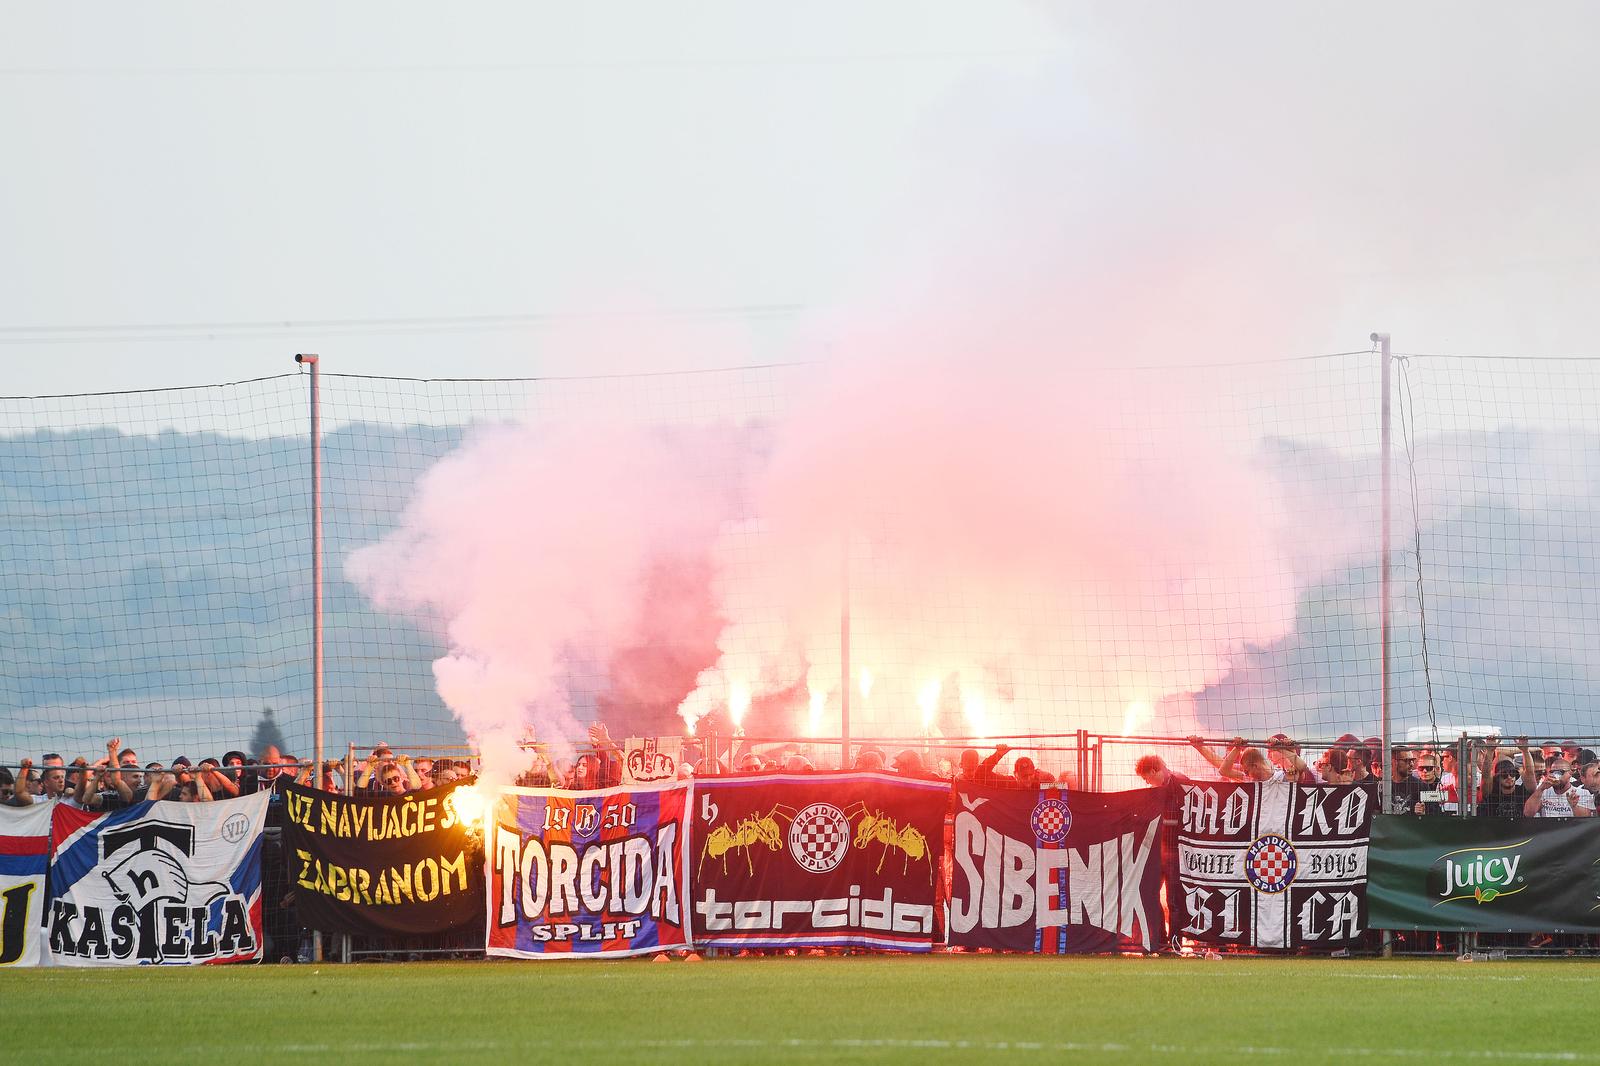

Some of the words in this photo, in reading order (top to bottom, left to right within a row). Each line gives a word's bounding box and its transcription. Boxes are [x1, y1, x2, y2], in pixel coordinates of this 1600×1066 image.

[286, 789, 315, 833] UZ
[320, 795, 437, 841] NAVIJAČE
[541, 804, 571, 831] 19
[603, 801, 637, 829] 50
[796, 806, 844, 828] HAJDUK
[1035, 800, 1068, 815] HAJDUK
[226, 820, 245, 839] VII
[1036, 829, 1065, 841] SPLIT
[1249, 836, 1293, 856] HAJDUK
[495, 821, 682, 926] TORCIDA
[800, 854, 837, 870] SPLIT
[950, 792, 1162, 952] ŠIBENIK
[1184, 851, 1236, 875] WHITE
[1311, 853, 1358, 878] BOYS
[296, 848, 468, 904] ZABRANOM
[1253, 878, 1287, 892] SPLIT
[1440, 854, 1521, 897] Juicy
[696, 884, 934, 934] torcida
[532, 919, 641, 942] SPLIT
